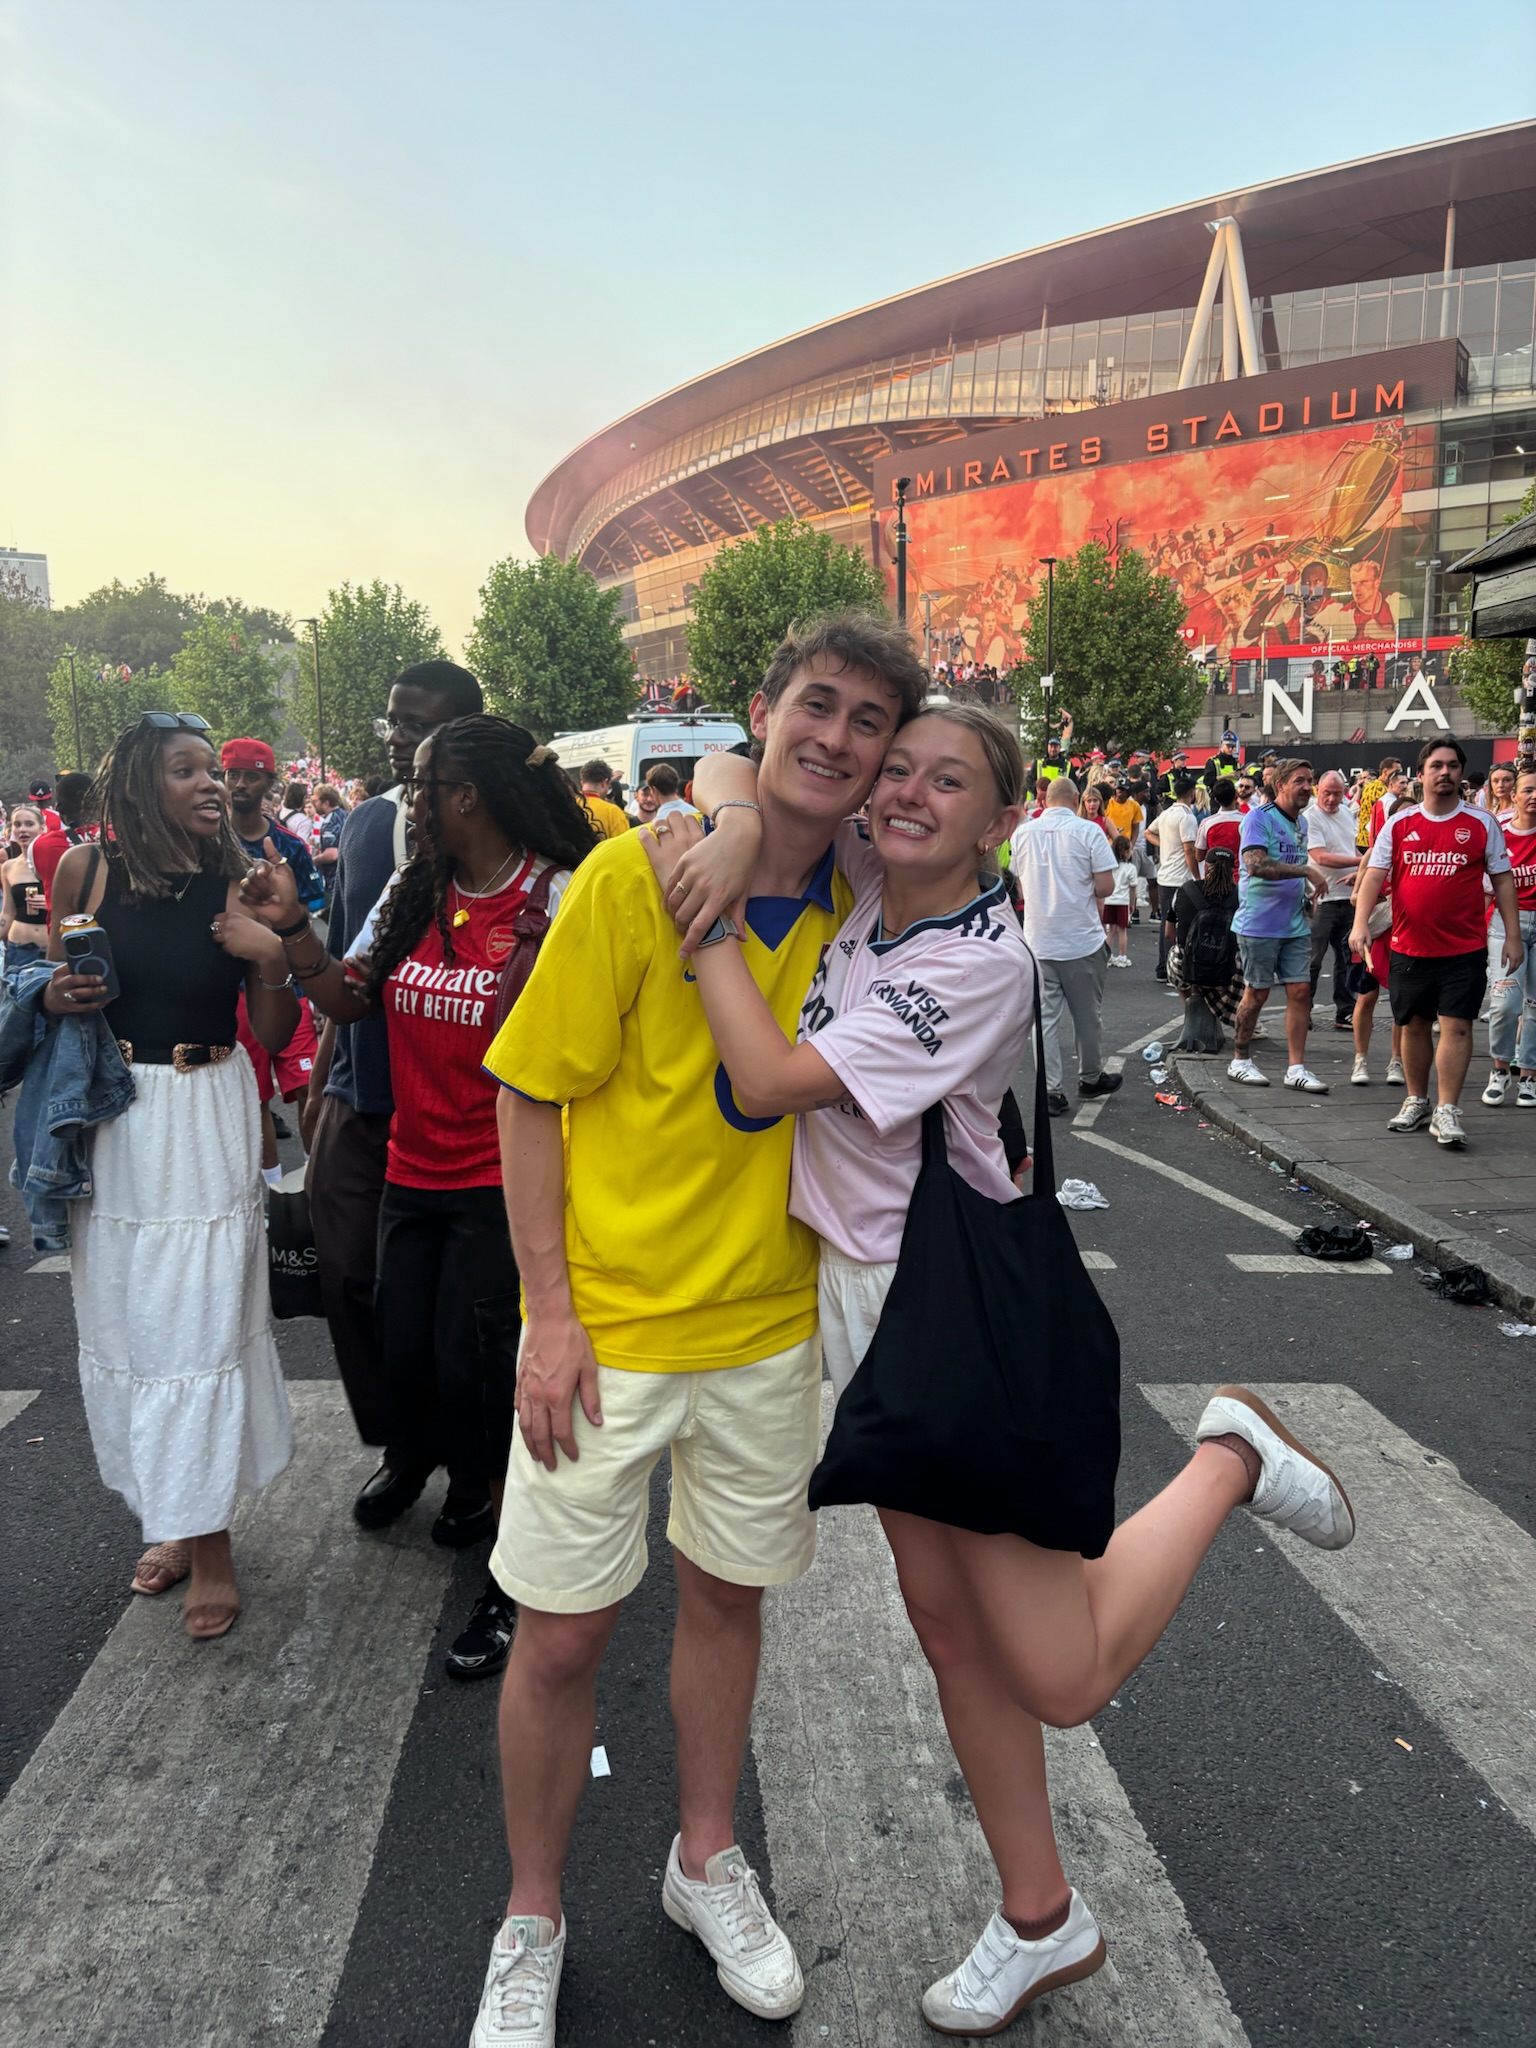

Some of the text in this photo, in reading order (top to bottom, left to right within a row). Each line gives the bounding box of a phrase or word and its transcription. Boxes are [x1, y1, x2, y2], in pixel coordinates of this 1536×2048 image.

[891, 380, 1405, 502] EMIRATES STADIUM
[1310, 640, 1418, 654] OFFCIAL MERCHANDISE
[571, 731, 607, 747] POLICE
[650, 743, 684, 753] POLICE
[1402, 849, 1468, 866] Emirates
[1409, 864, 1457, 877] FLY BETTER
[388, 955, 503, 997] mirate
[394, 987, 486, 1027] FLY BETTER
[906, 979, 950, 1026] VISIT
[875, 983, 944, 1058] RWANDA
[271, 1246, 318, 1267] M&S
